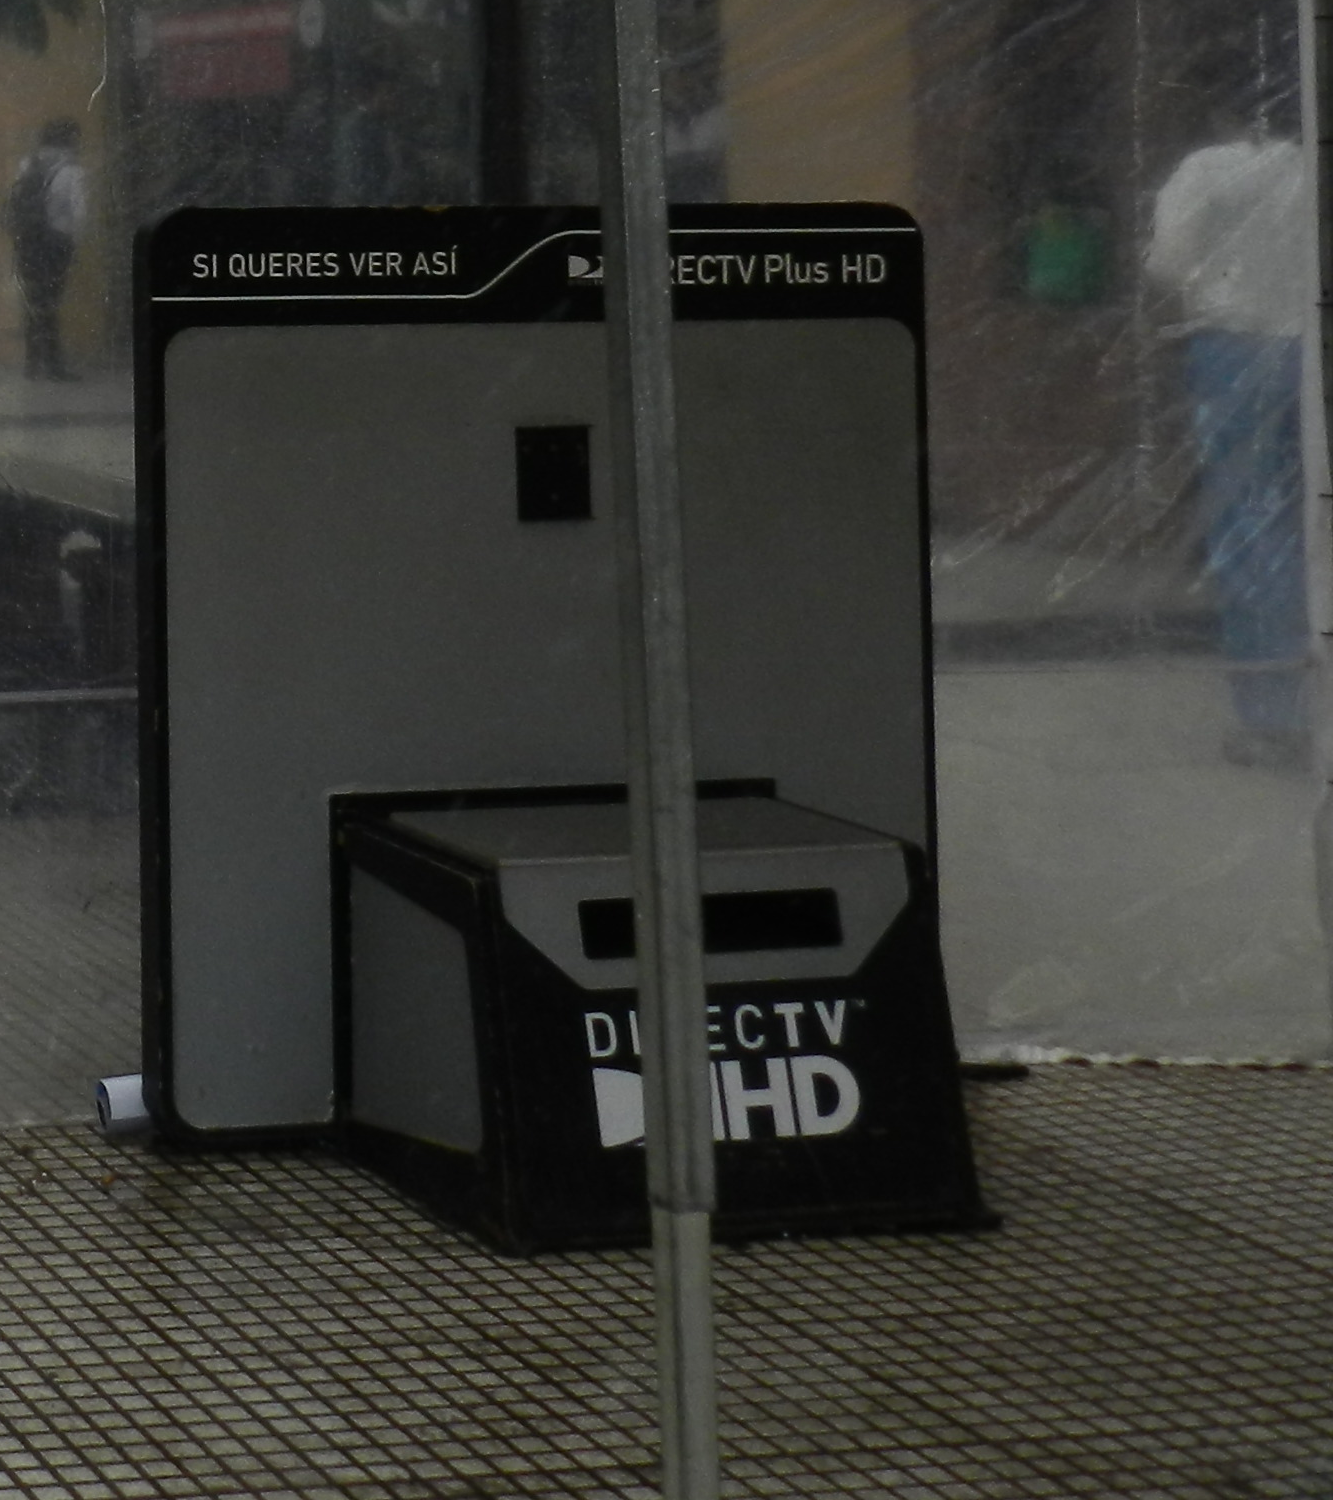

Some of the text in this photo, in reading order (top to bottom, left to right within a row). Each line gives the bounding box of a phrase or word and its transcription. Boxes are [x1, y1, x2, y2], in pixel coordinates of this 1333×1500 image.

[192, 245, 459, 279] SI QUERES VER ASÍ
[764, 253, 830, 284] Plus
[841, 253, 887, 284] HD
[584, 999, 847, 1058] DIECTV
